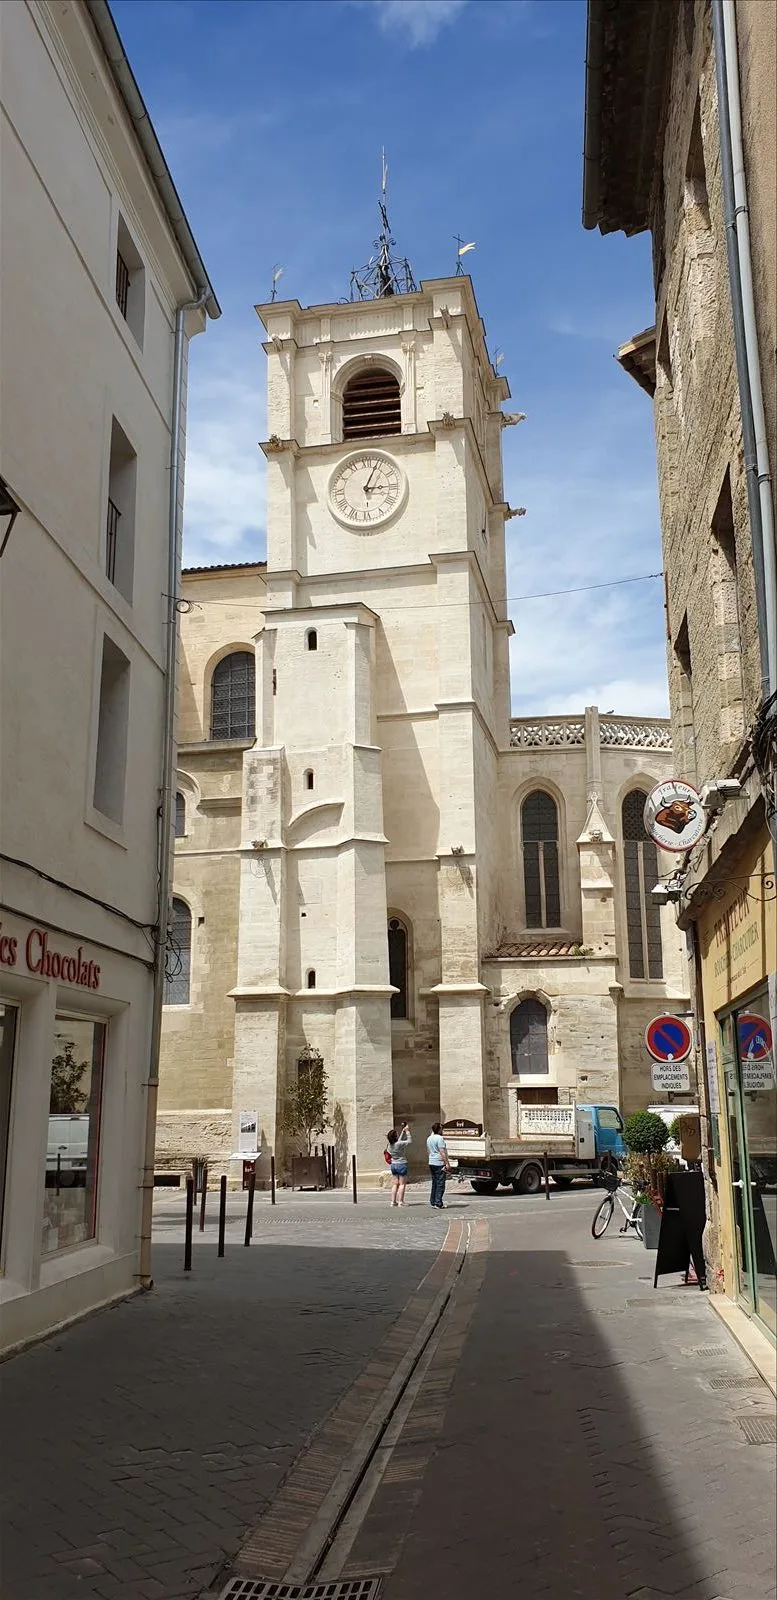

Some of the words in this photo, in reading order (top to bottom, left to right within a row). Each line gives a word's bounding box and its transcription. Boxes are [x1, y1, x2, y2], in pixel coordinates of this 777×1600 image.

[0, 923, 18, 966] es
[25, 928, 101, 990] Chocolats
[653, 1073, 689, 1081] EMPLACEMENTS
